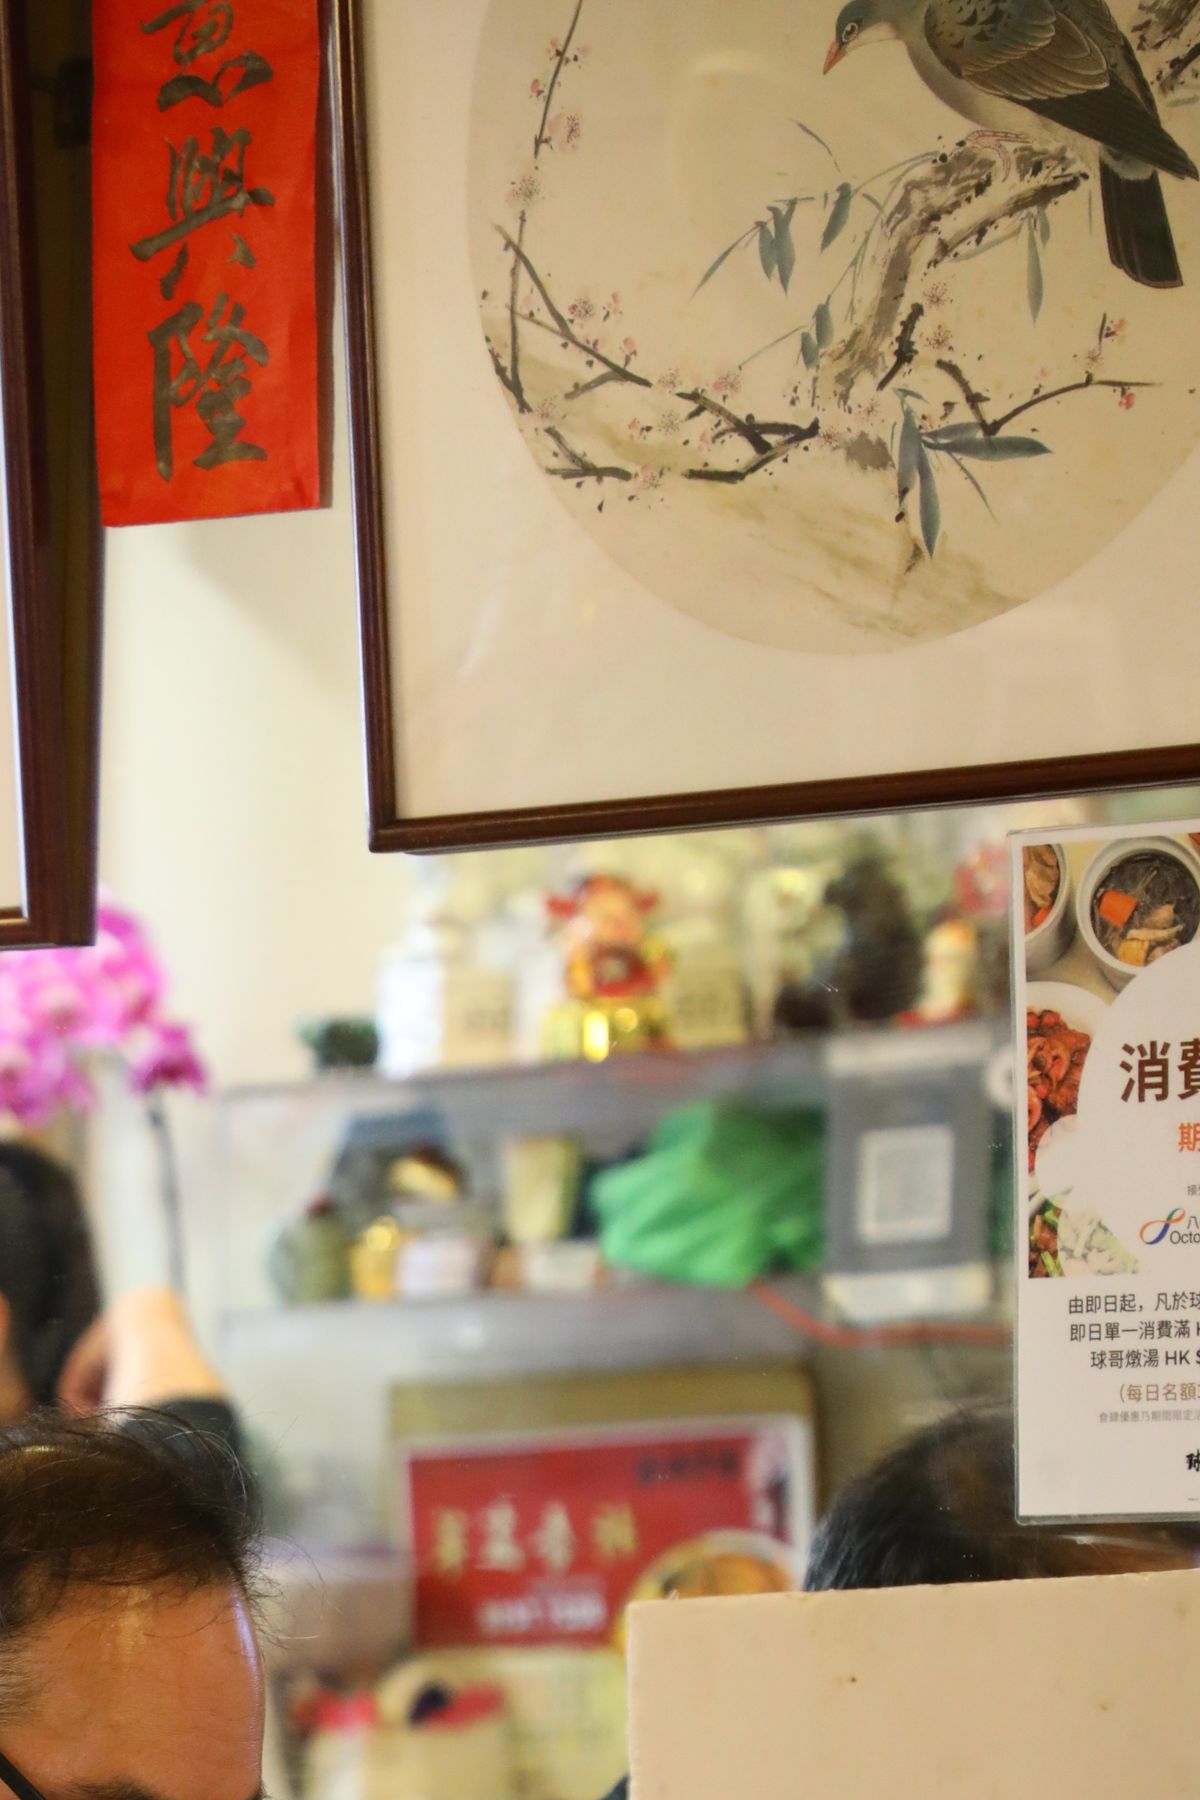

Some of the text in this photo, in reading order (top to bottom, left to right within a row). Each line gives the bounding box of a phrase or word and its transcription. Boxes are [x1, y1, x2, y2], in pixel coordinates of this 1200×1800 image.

[1070, 1320, 1191, 1342] 即日單一消費滿
[1090, 1349, 1160, 1369] 球哥燉湯
[1165, 1350, 1191, 1366] HK
[1119, 1383, 1200, 1404] (每日名額
